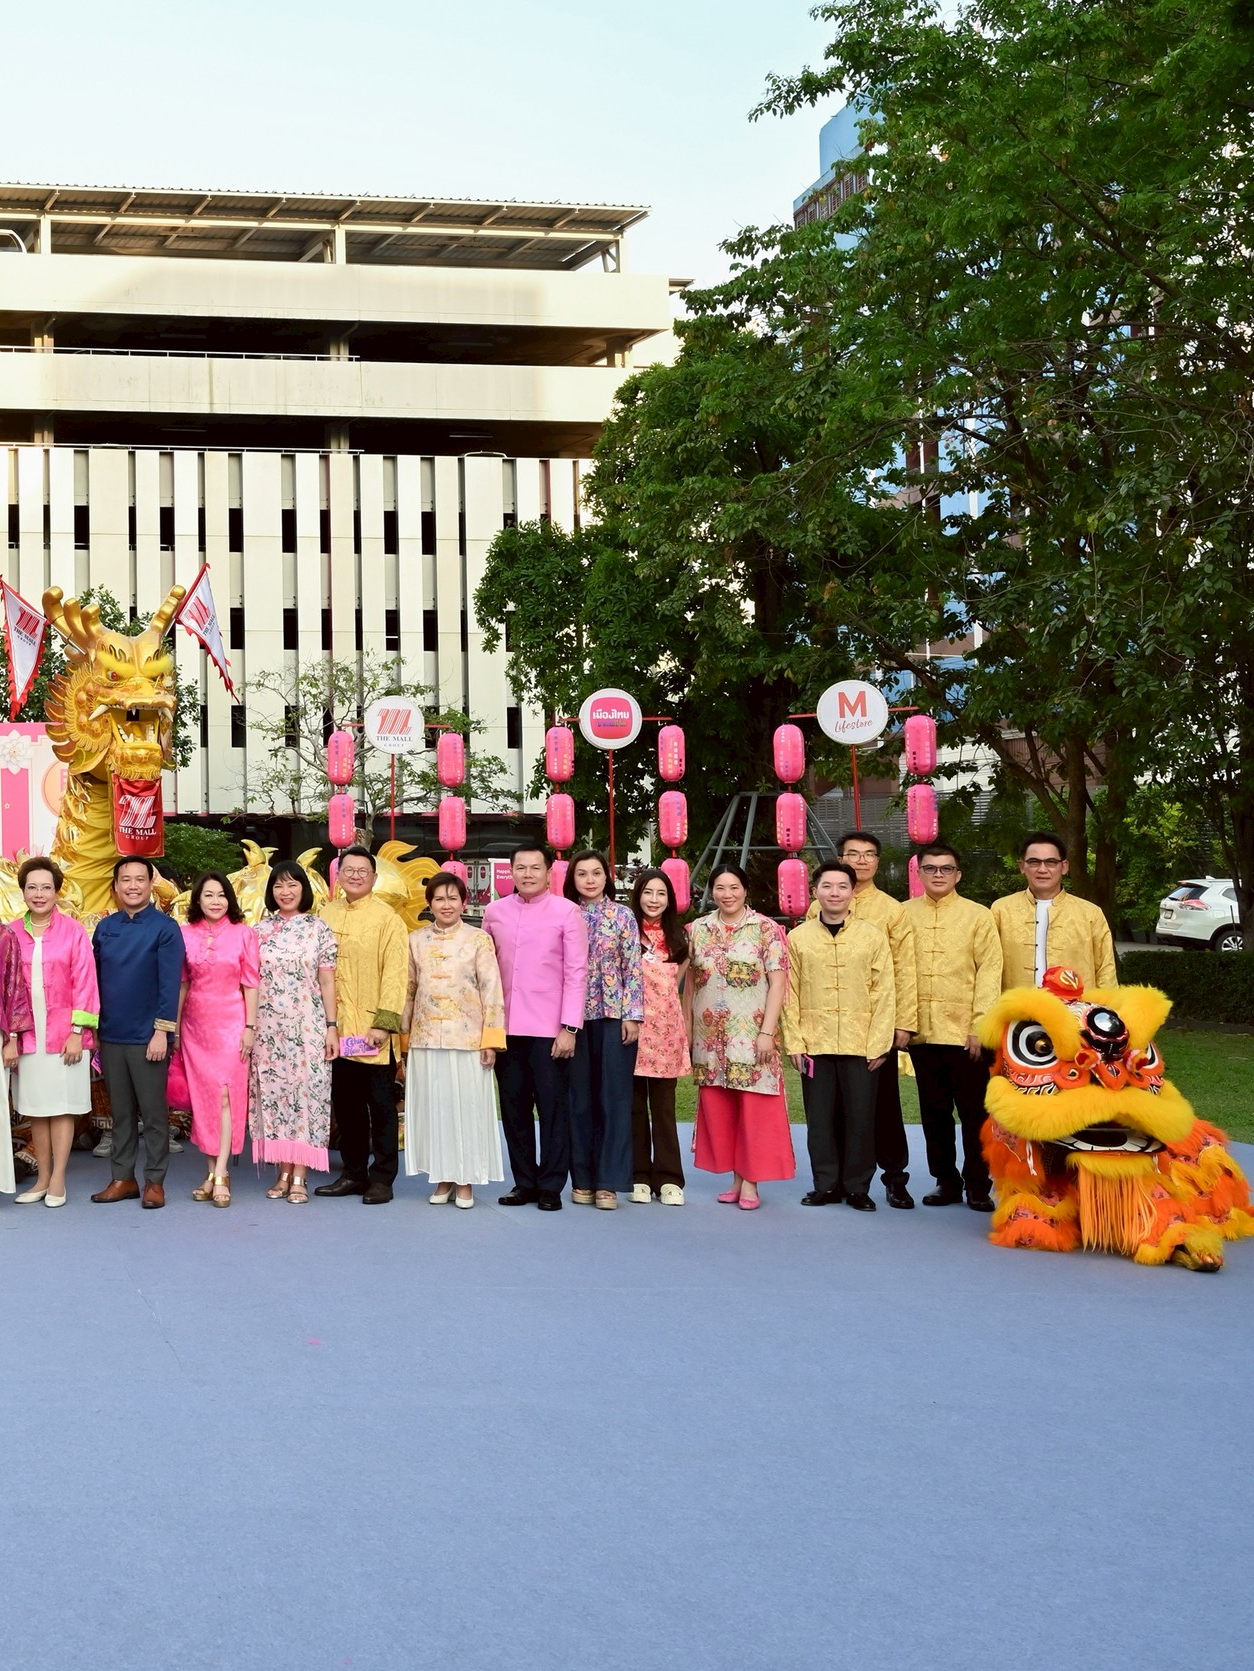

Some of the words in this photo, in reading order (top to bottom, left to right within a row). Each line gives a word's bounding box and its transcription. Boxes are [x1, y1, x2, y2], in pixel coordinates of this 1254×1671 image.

[838, 690, 867, 719] M
[592, 708, 630, 719] เมืองไทย
[118, 826, 134, 834] THE
[135, 828, 157, 836] MALL
